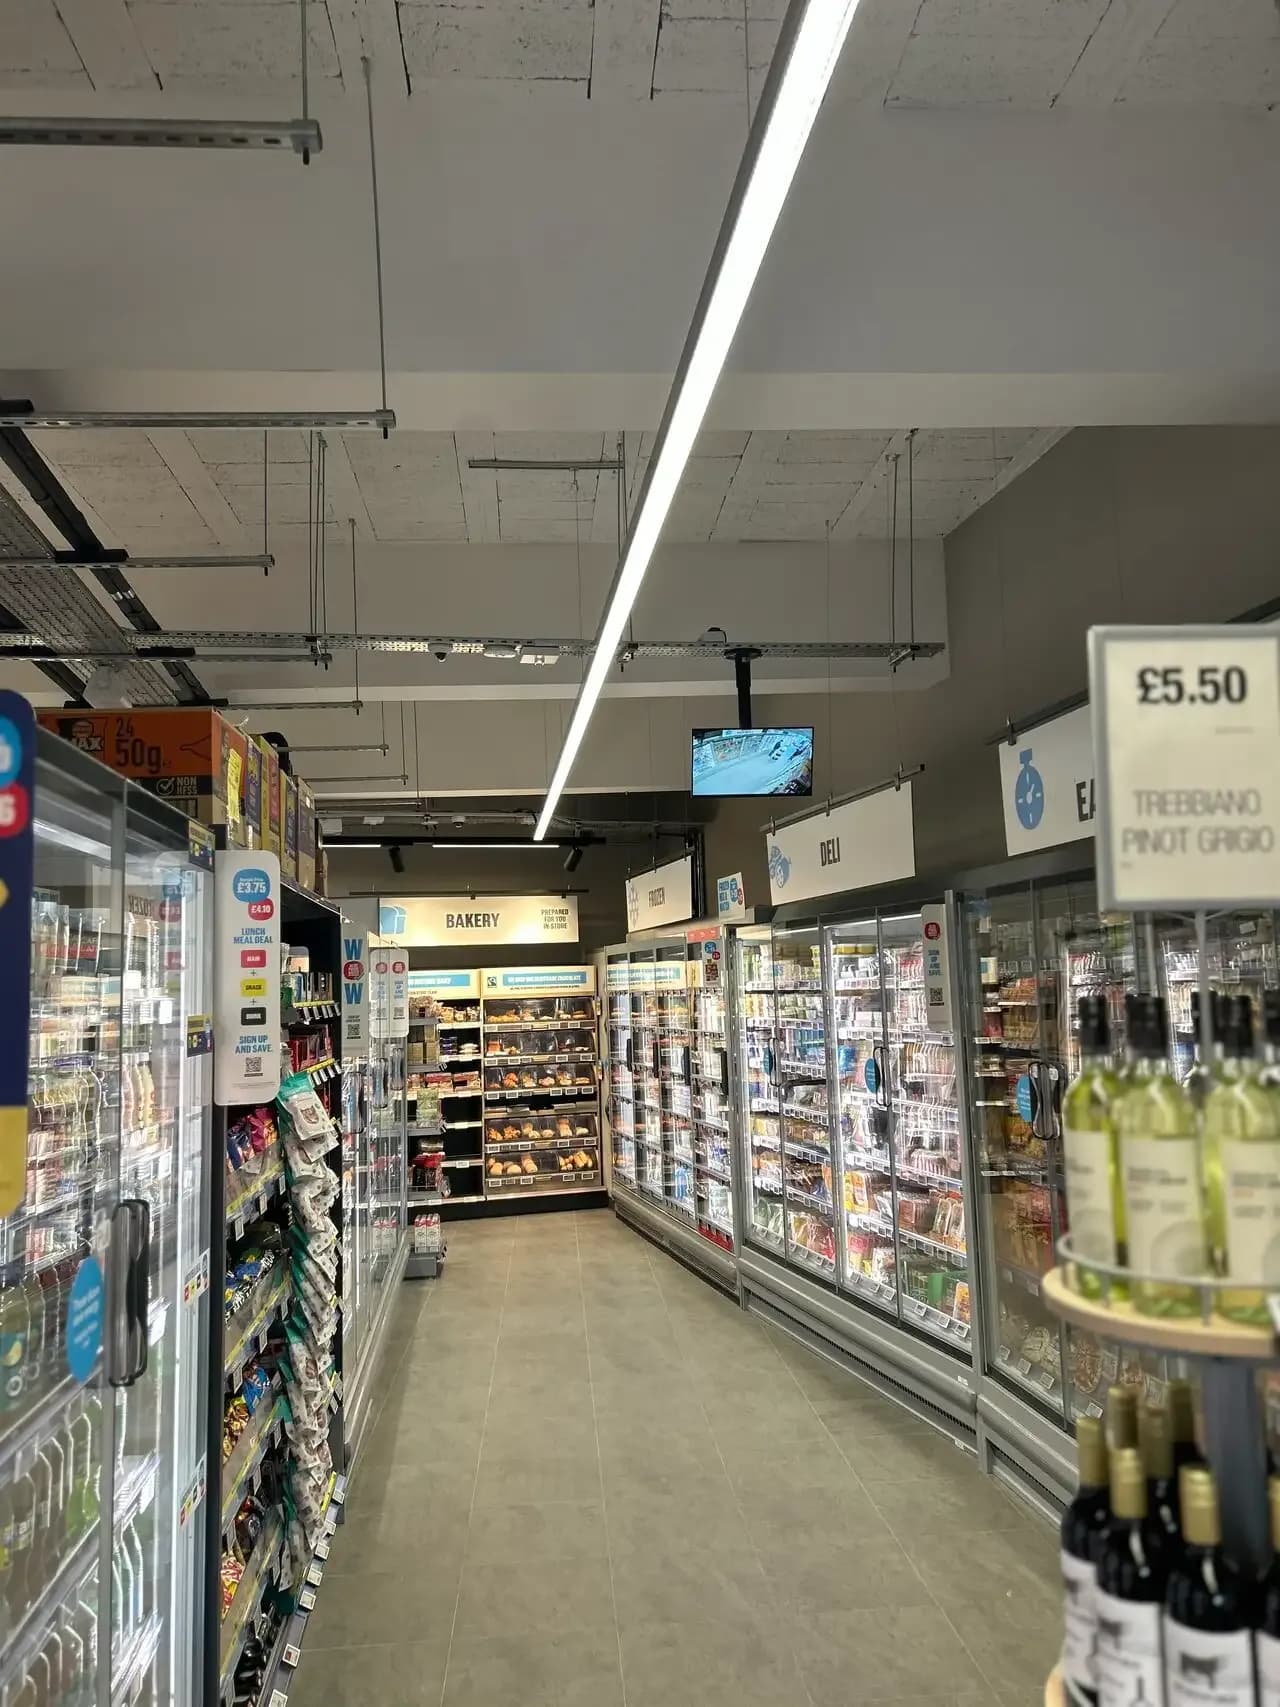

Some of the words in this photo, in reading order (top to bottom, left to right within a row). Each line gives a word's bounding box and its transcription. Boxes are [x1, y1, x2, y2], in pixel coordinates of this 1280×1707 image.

[1137, 666, 1249, 705] £5.50
[116, 718, 134, 737] 24
[115, 738, 162, 774] 50g
[176, 777, 197, 786] NON
[1132, 789, 1262, 816] TREBBIANO
[1121, 827, 1191, 855] PINOT
[1197, 825, 1276, 853] GRIGIO
[820, 837, 841, 867] DELI
[236, 882, 267, 894] £3.75
[541, 908, 569, 916] PREPARED
[446, 913, 500, 929] BAKERY
[241, 927, 266, 936] LUNCH
[233, 936, 254, 945] MEAL
[254, 935, 273, 944] DEAL
[239, 1035, 257, 1044] SIGN
[257, 1035, 268, 1044] UP
[235, 1045, 251, 1055] AND
